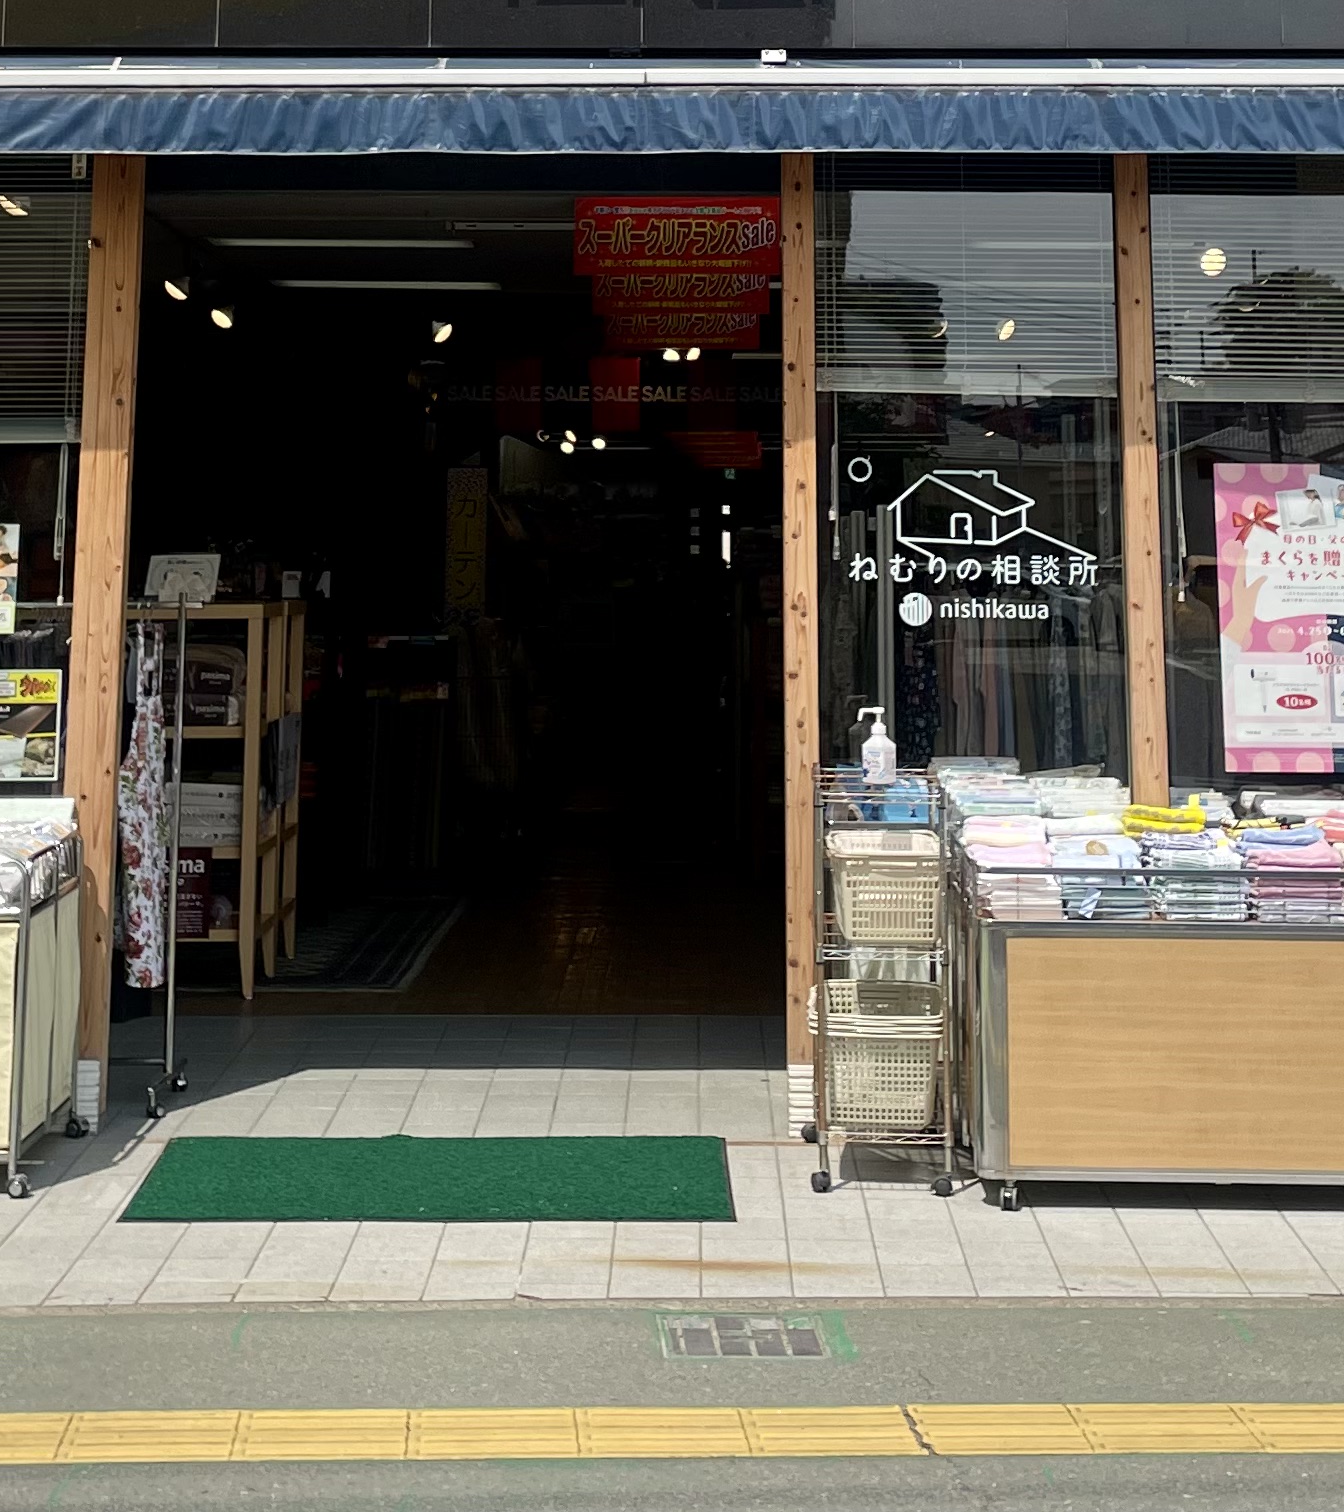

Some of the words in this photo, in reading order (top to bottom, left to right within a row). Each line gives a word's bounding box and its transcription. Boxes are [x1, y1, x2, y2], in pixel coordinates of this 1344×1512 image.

[577, 217, 776, 255] スーパークリアランスsale
[495, 386, 540, 402] SALE
[544, 386, 589, 402] SALE
[593, 386, 639, 402] SALE
[642, 386, 687, 402] SALE
[690, 386, 736, 402] SALE
[453, 498, 477, 600] カーテン
[848, 552, 1099, 587] ねむりの相談所
[939, 599, 1050, 620] nishikawa
